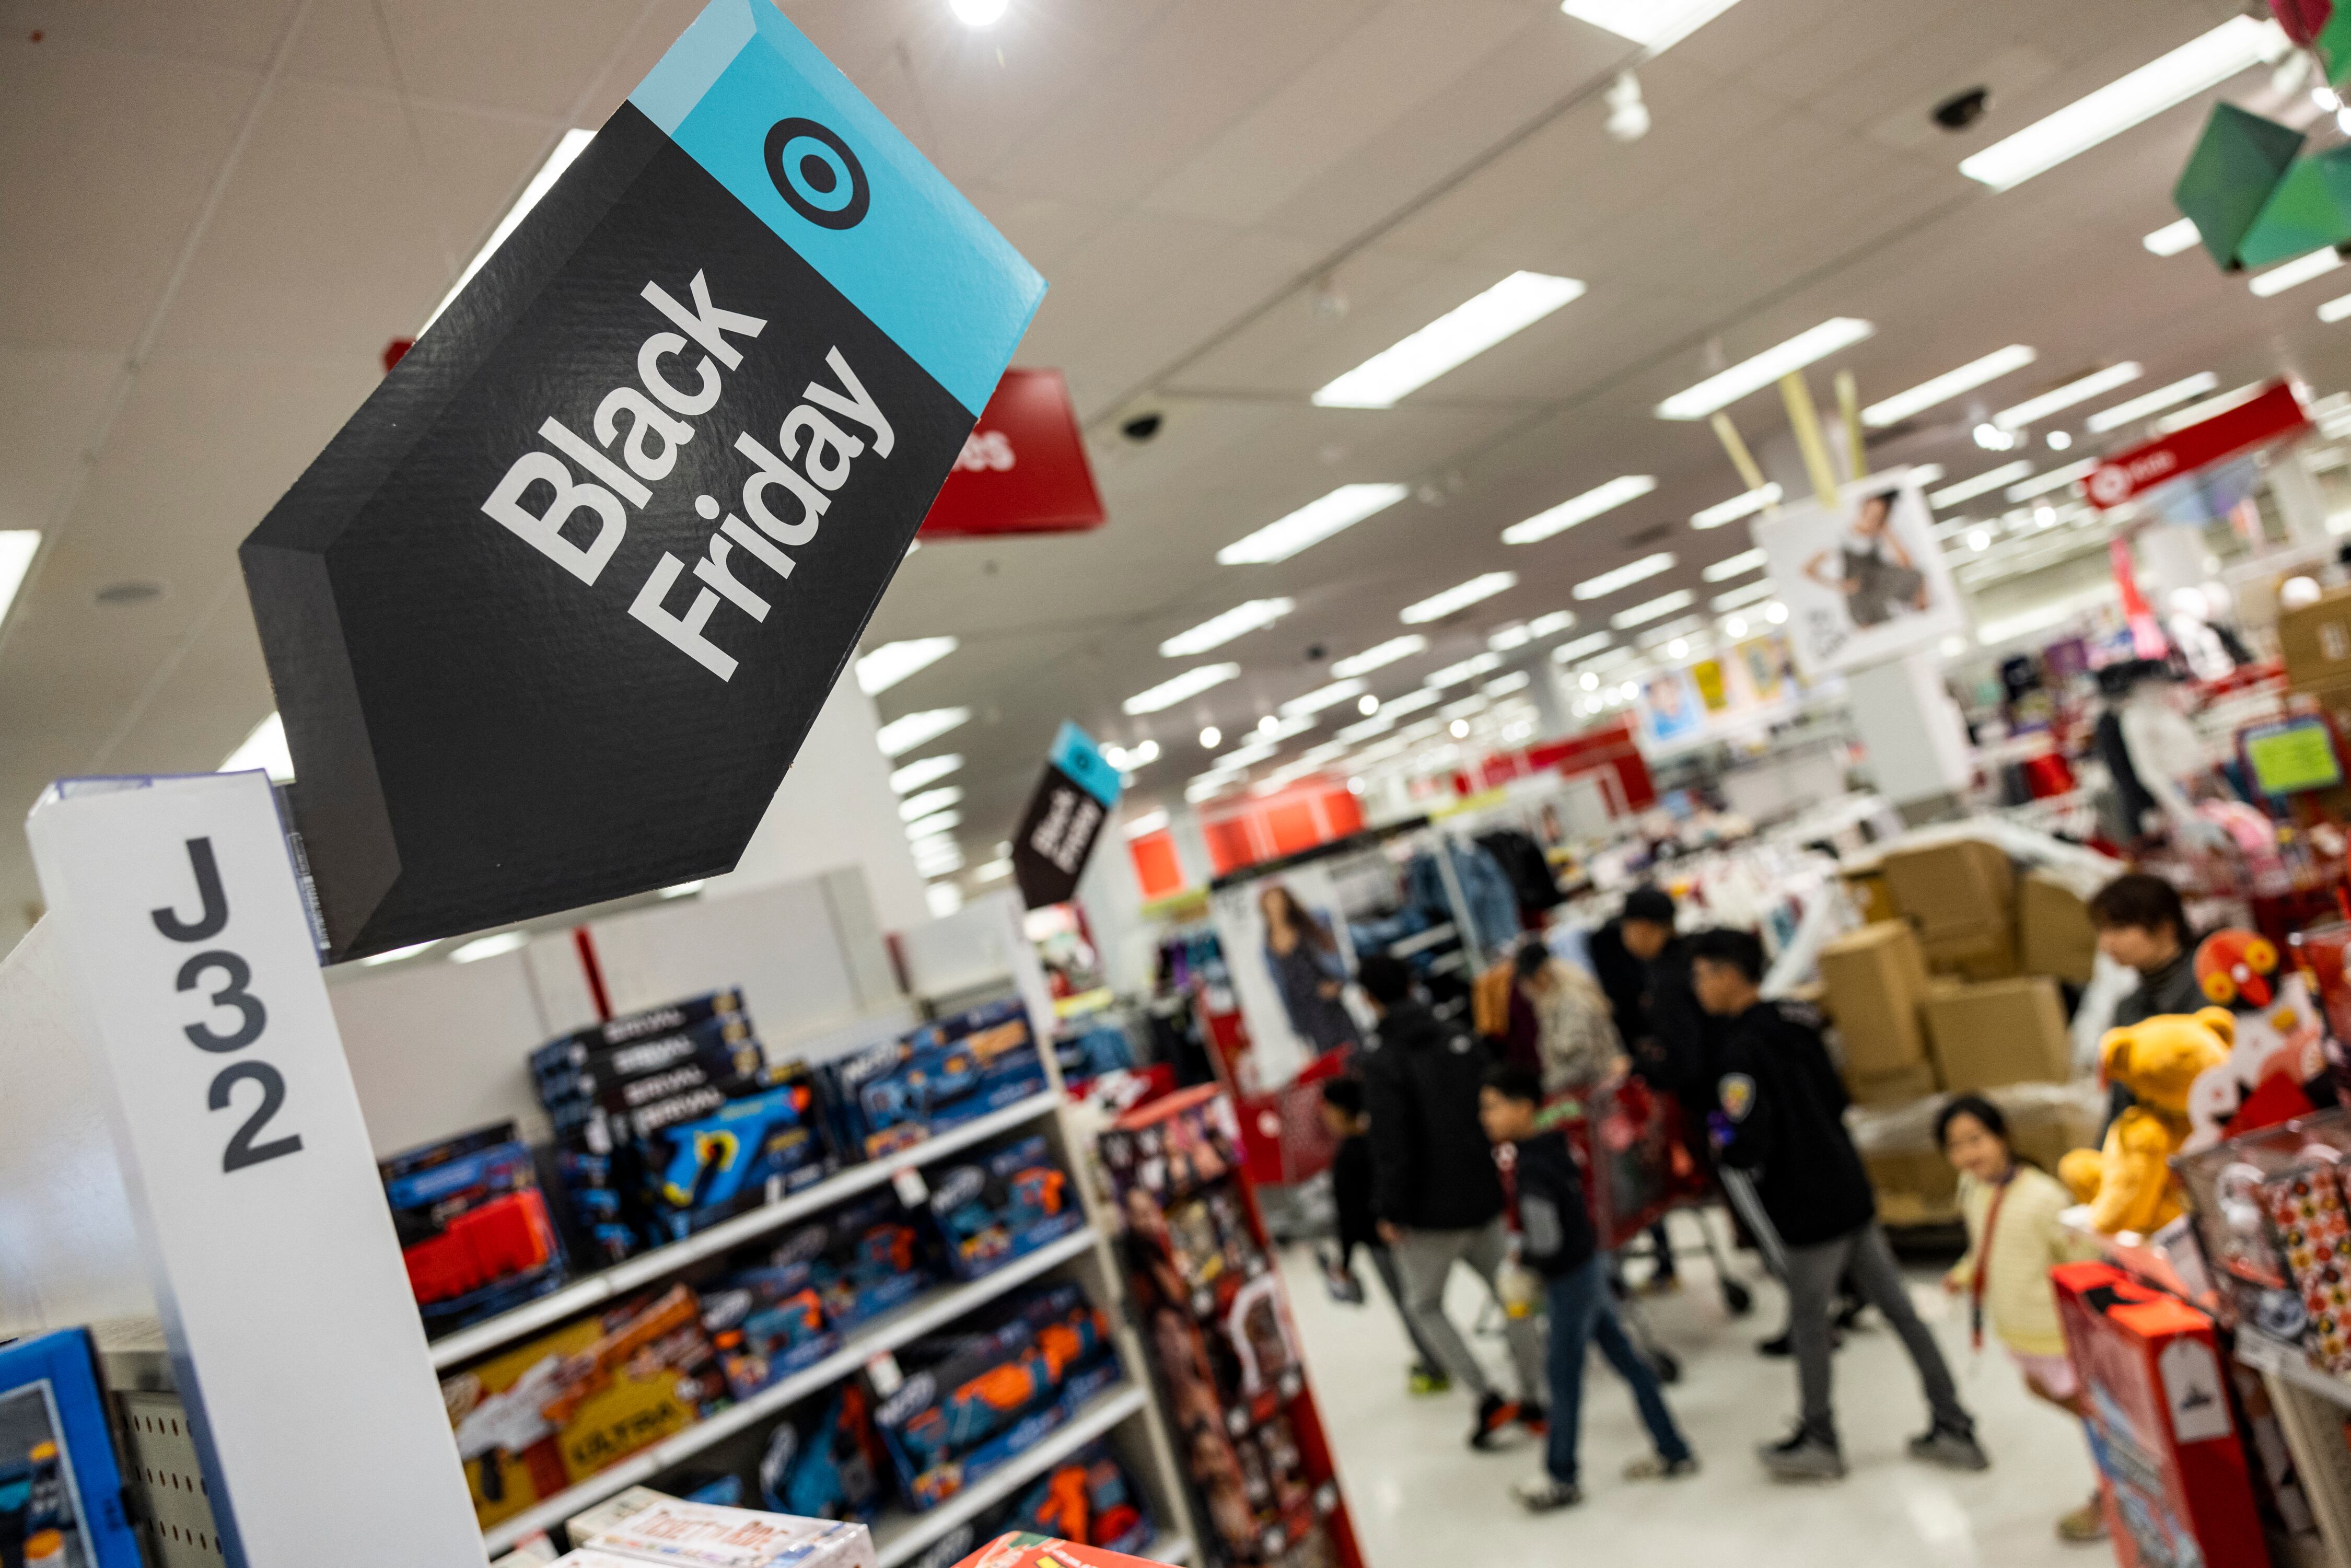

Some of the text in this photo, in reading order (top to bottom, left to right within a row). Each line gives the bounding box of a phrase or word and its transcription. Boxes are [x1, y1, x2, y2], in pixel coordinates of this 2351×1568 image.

[481, 268, 768, 586] Black
[627, 345, 894, 682] Friday
[152, 837, 303, 1173] J32
